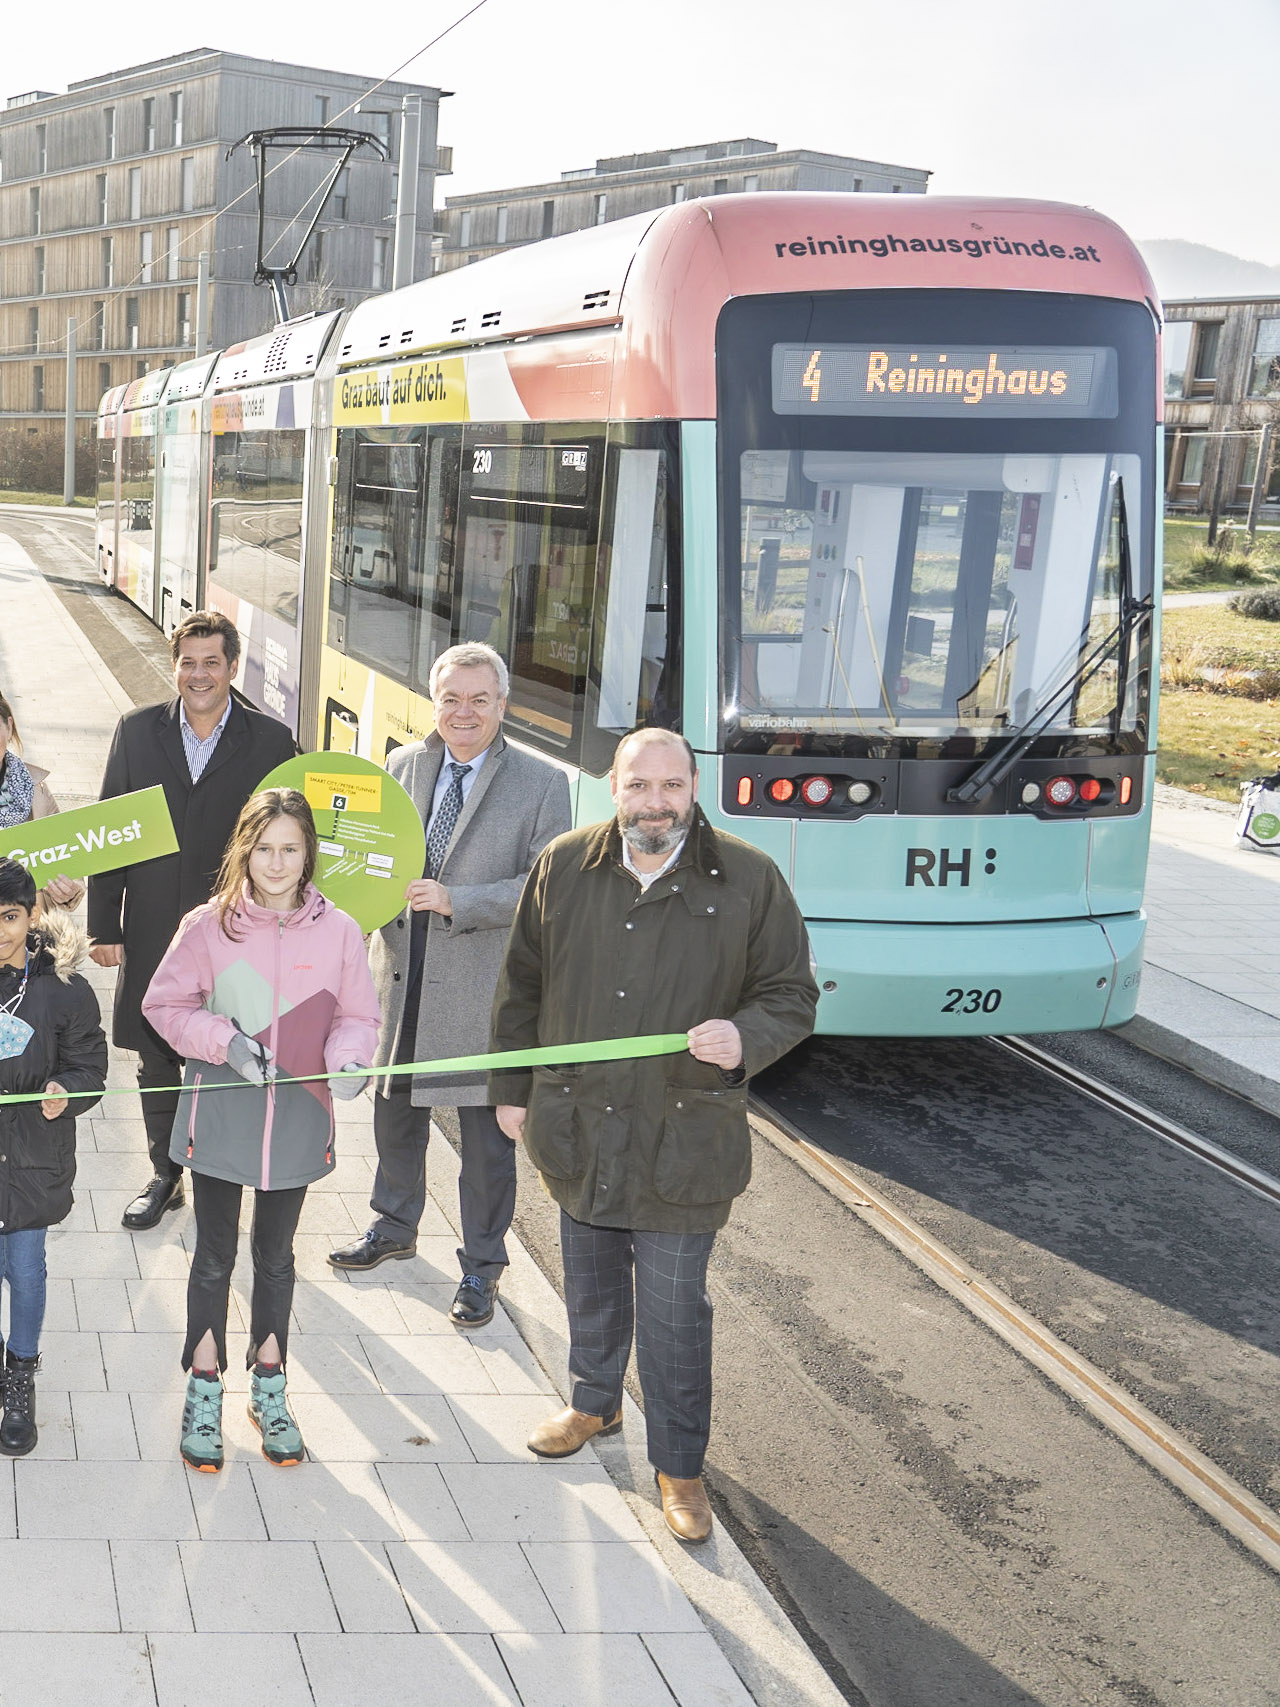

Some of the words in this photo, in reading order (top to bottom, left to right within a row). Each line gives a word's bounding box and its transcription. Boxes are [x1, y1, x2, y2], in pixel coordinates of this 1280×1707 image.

[775, 234, 1102, 264] reininghausgründe.at
[342, 378, 363, 409] Graz
[365, 375, 391, 407] baut
[393, 367, 413, 405] auf
[415, 363, 447, 402] dich.
[802, 350, 822, 402] 4
[866, 351, 1068, 404] Reininghaus
[472, 450, 492, 473] 230
[748, 716, 807, 728] variobahn
[335, 798, 344, 808] 6
[7, 819, 142, 868] Graz-West
[940, 988, 1002, 1014] 230
